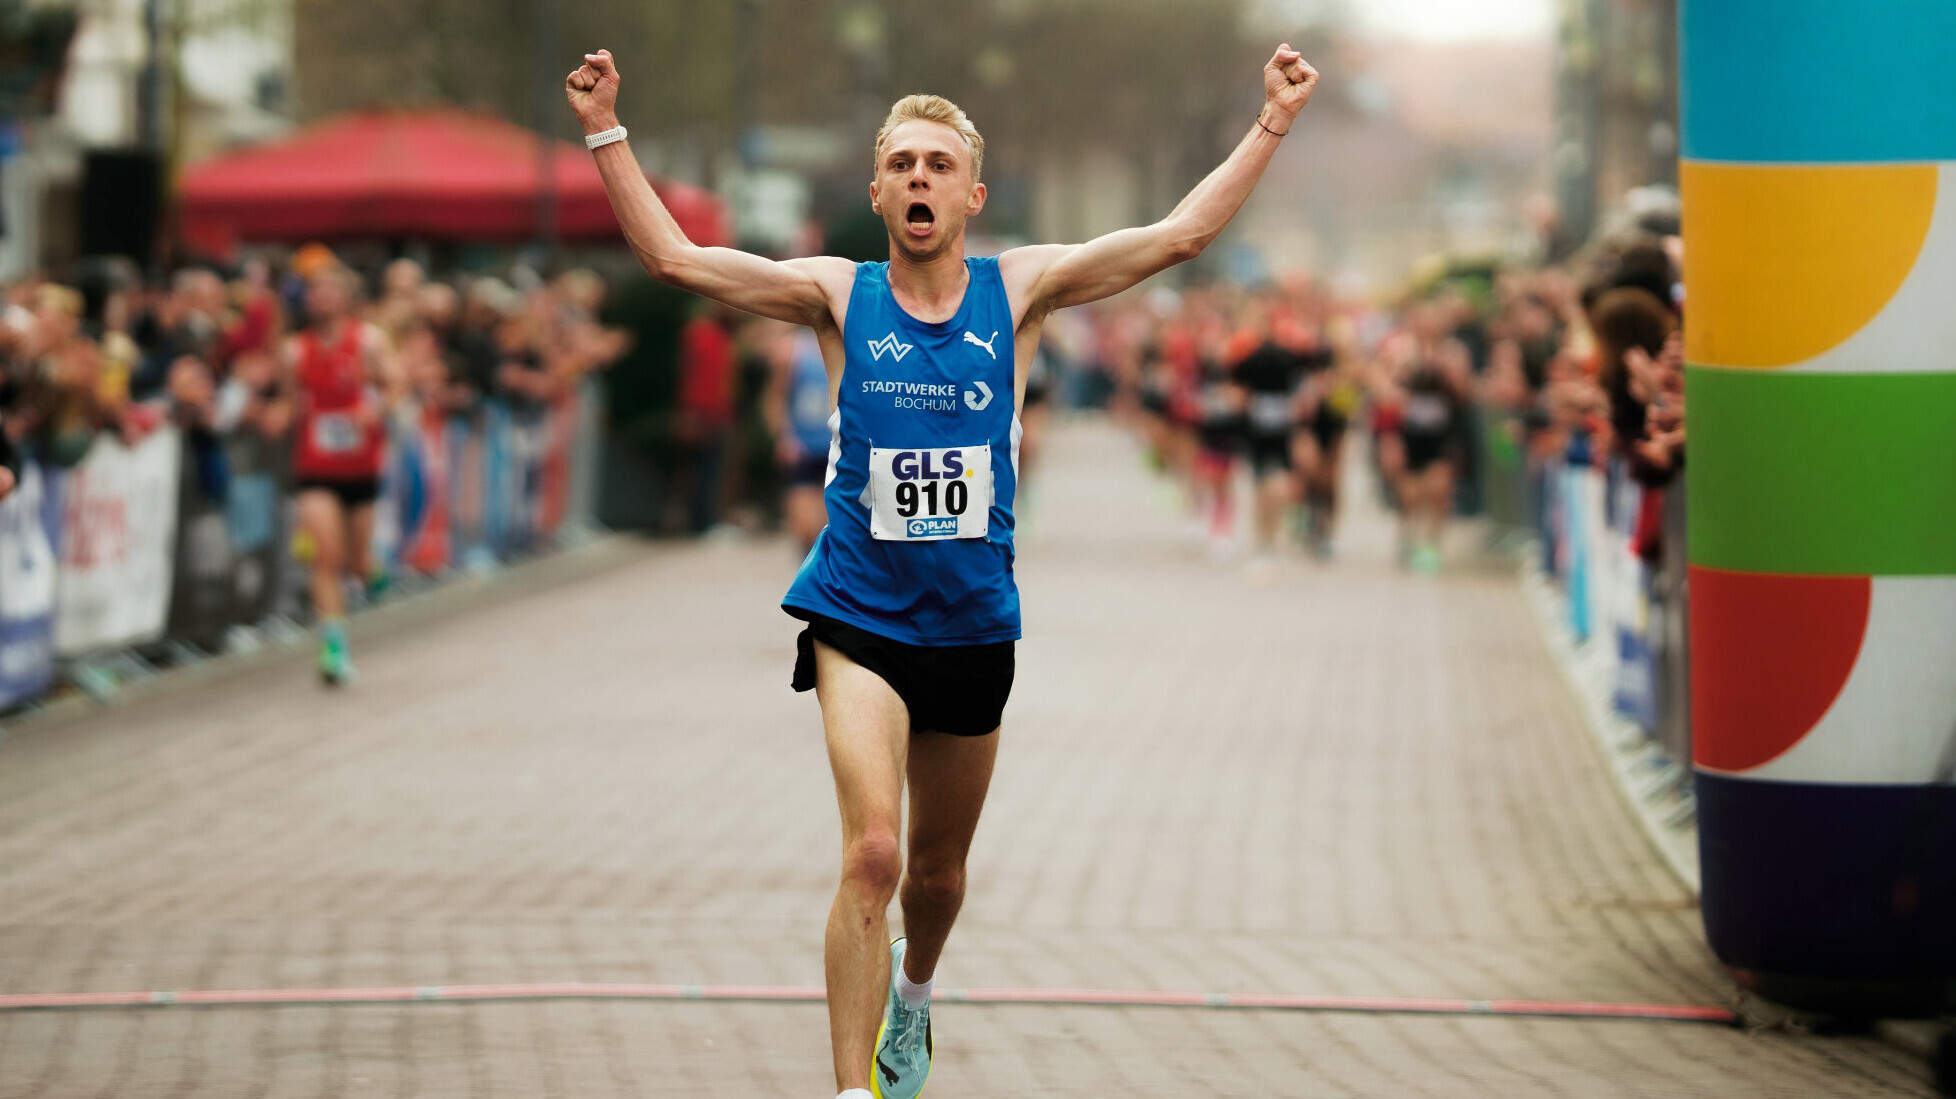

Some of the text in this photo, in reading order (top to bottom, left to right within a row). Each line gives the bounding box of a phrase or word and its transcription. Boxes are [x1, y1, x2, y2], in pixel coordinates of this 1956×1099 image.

[862, 381, 956, 396] STADTWERKE
[894, 397, 956, 411] BOCHUM
[895, 481, 968, 517] 910
[928, 520, 956, 530] PLAN
